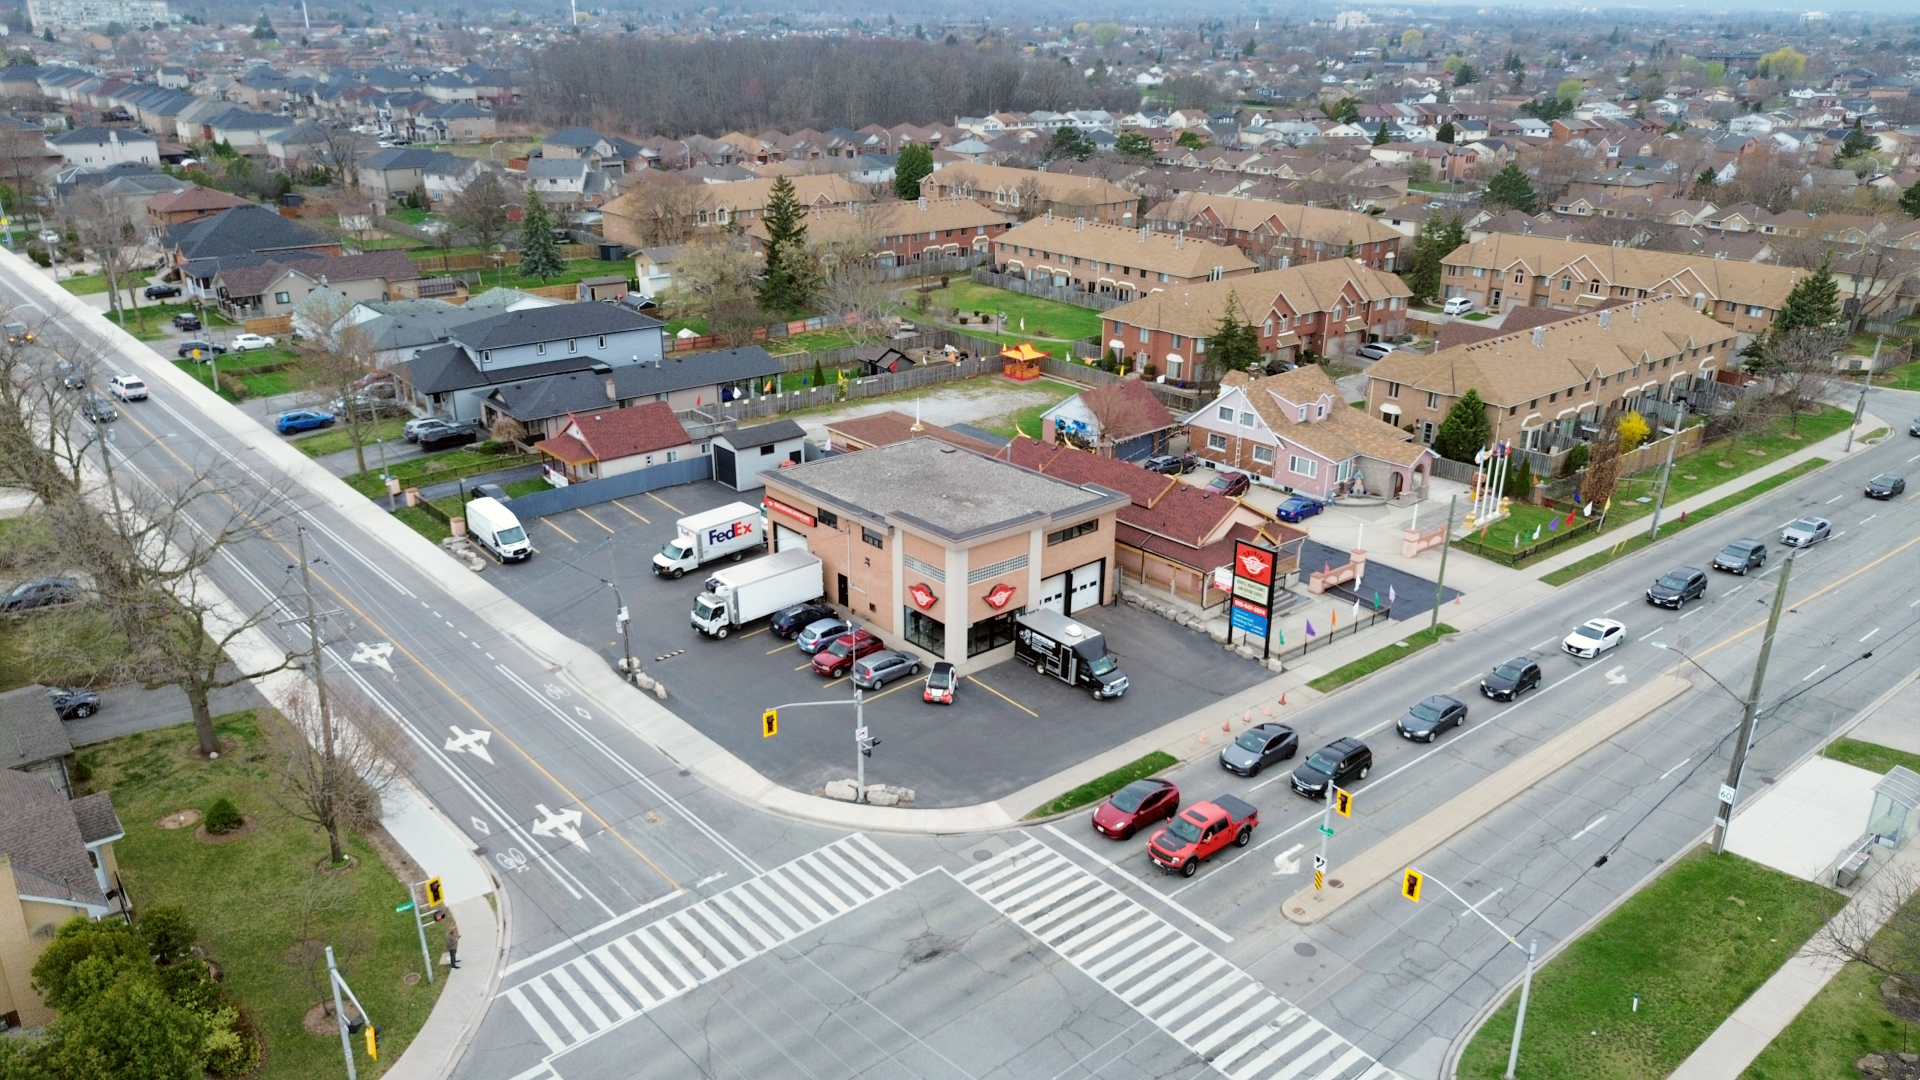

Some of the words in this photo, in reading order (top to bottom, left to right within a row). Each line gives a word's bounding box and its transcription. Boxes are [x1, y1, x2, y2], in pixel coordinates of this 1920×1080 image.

[681, 528, 693, 538] FedEx
[709, 521, 753, 545] FedEx
[1243, 550, 1265, 563] TRINITY
[1720, 790, 1732, 801] 60
